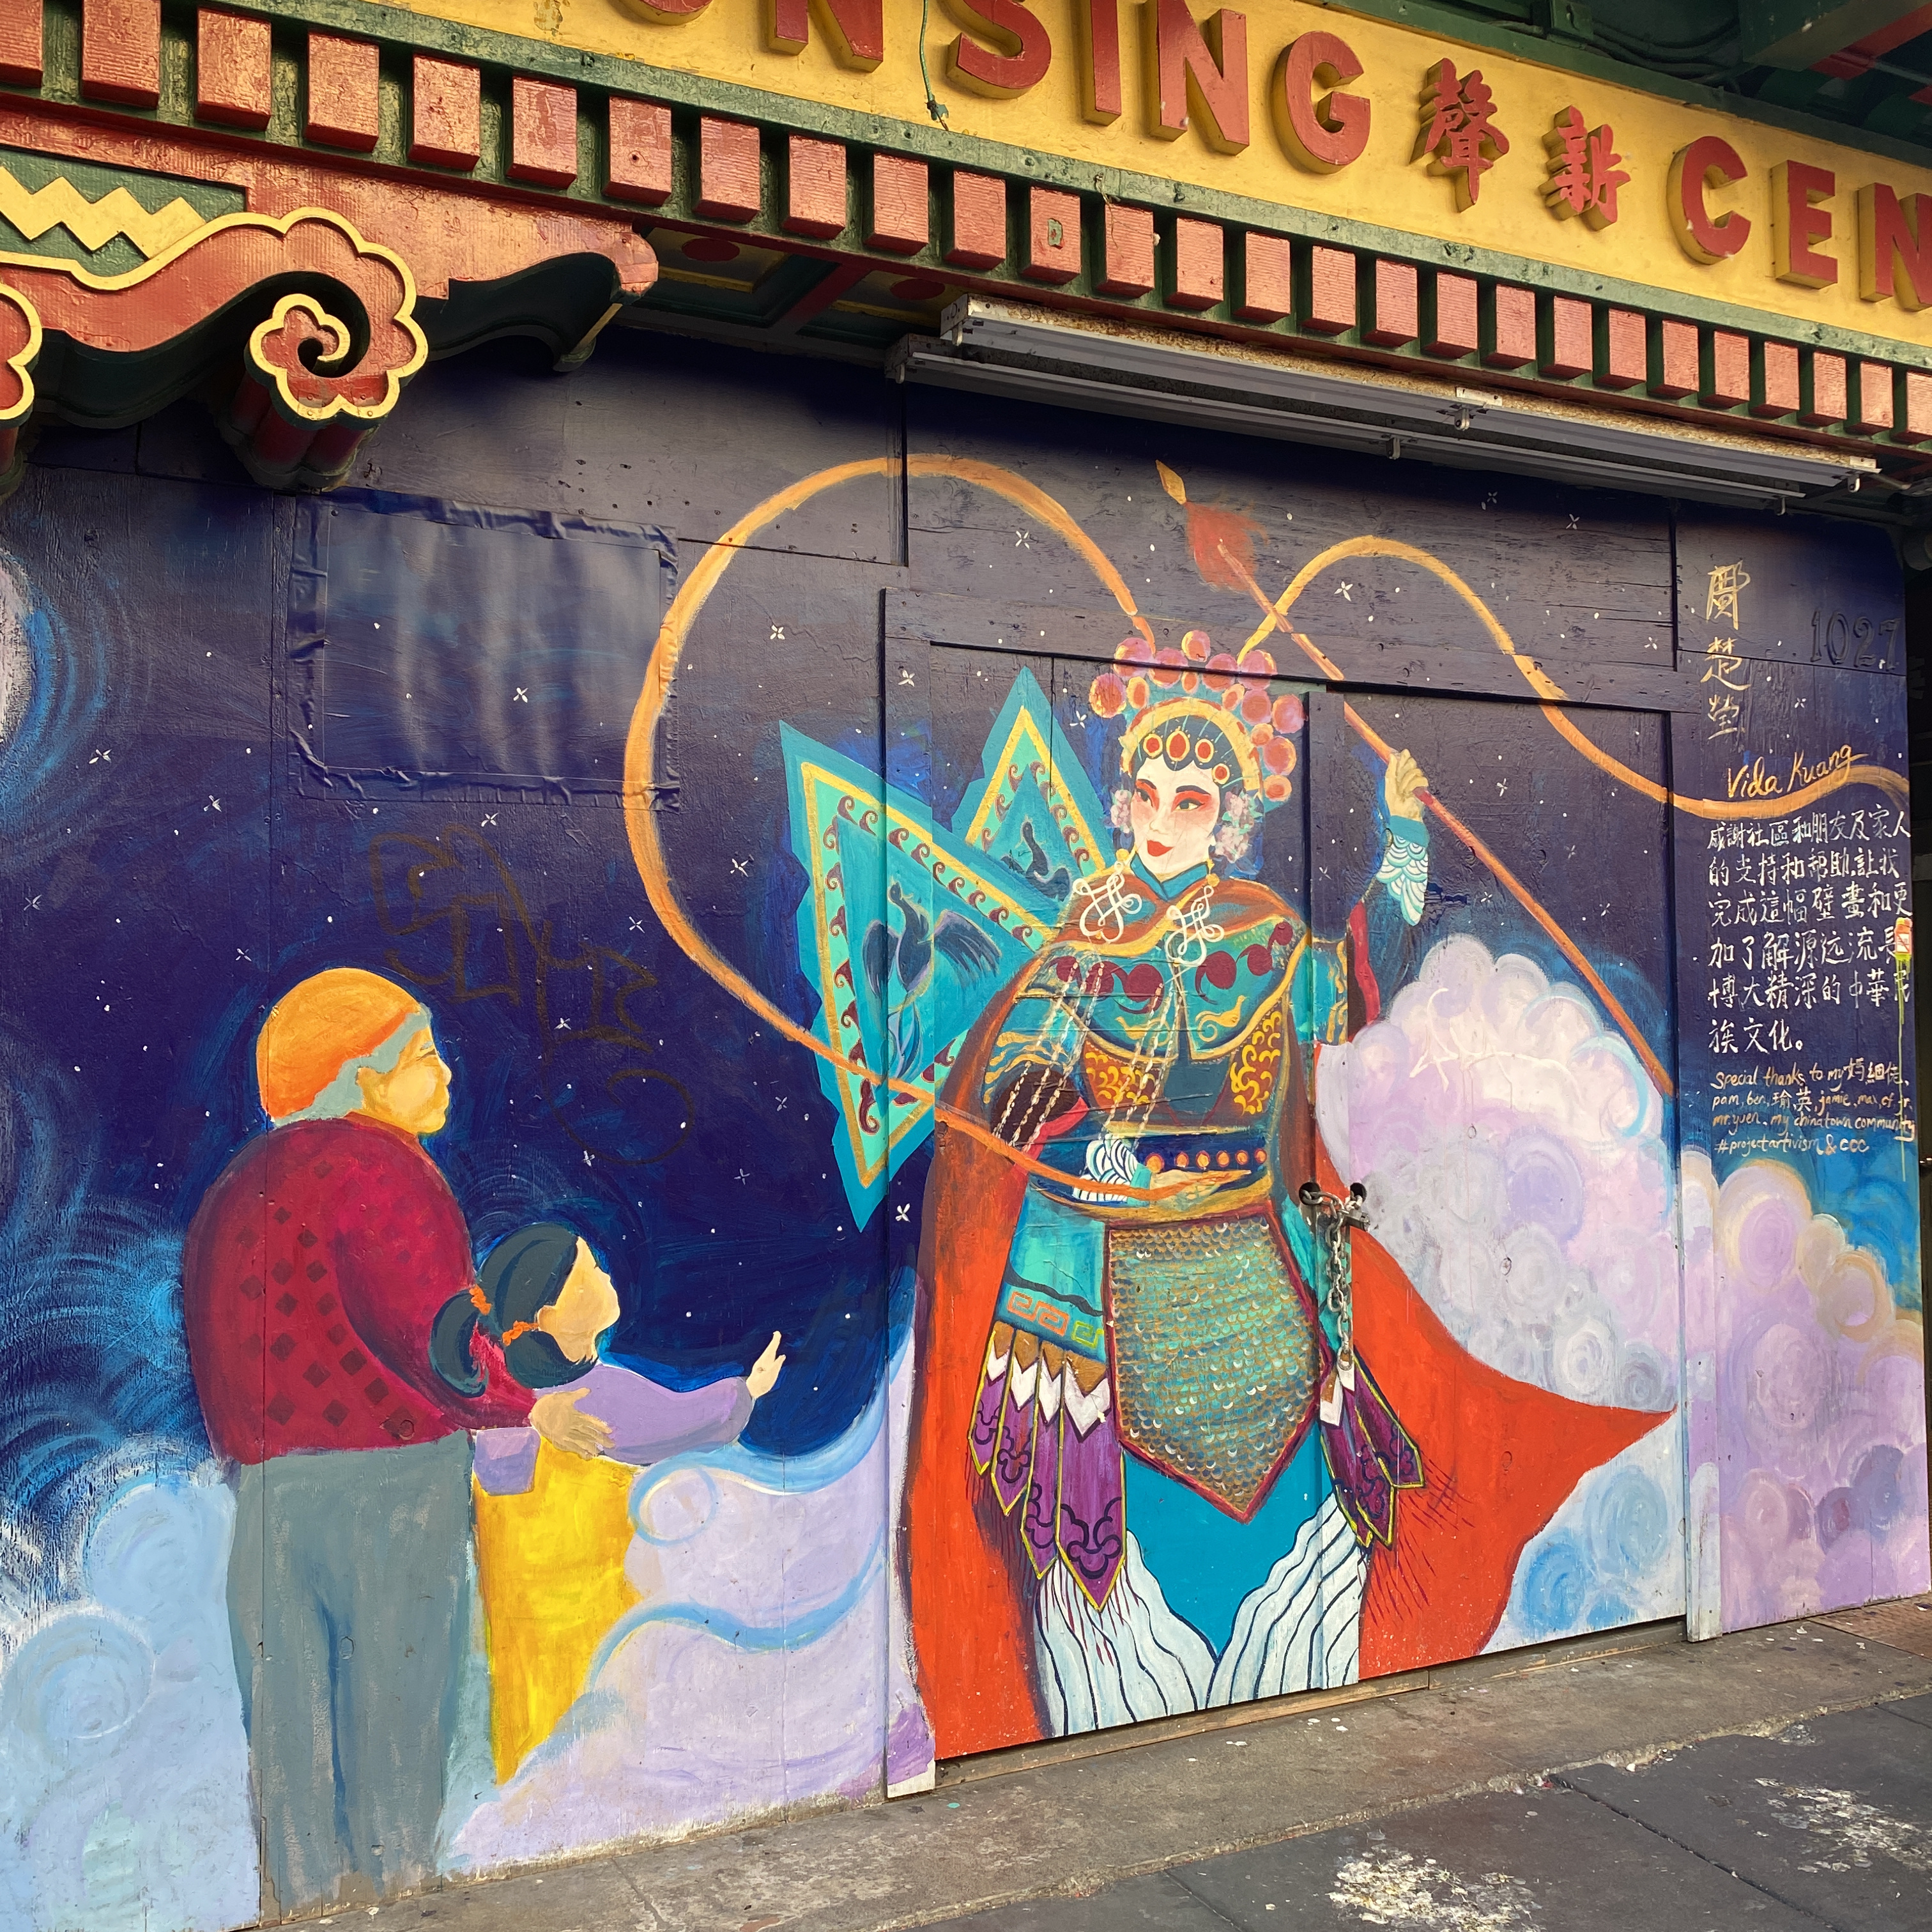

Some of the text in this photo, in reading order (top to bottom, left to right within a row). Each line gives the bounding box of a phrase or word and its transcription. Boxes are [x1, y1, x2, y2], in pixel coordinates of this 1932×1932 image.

[1811, 608, 1901, 671] 1027
[1728, 744, 1869, 799] Vida Kuang
[1763, 1062, 1807, 1087] thanks
[1809, 1062, 1823, 1081] to
[1827, 1068, 1844, 1092] my
[1770, 1113, 1790, 1137] my
[1793, 1110, 1853, 1129] chinatown
[1825, 1133, 1837, 1156] &
